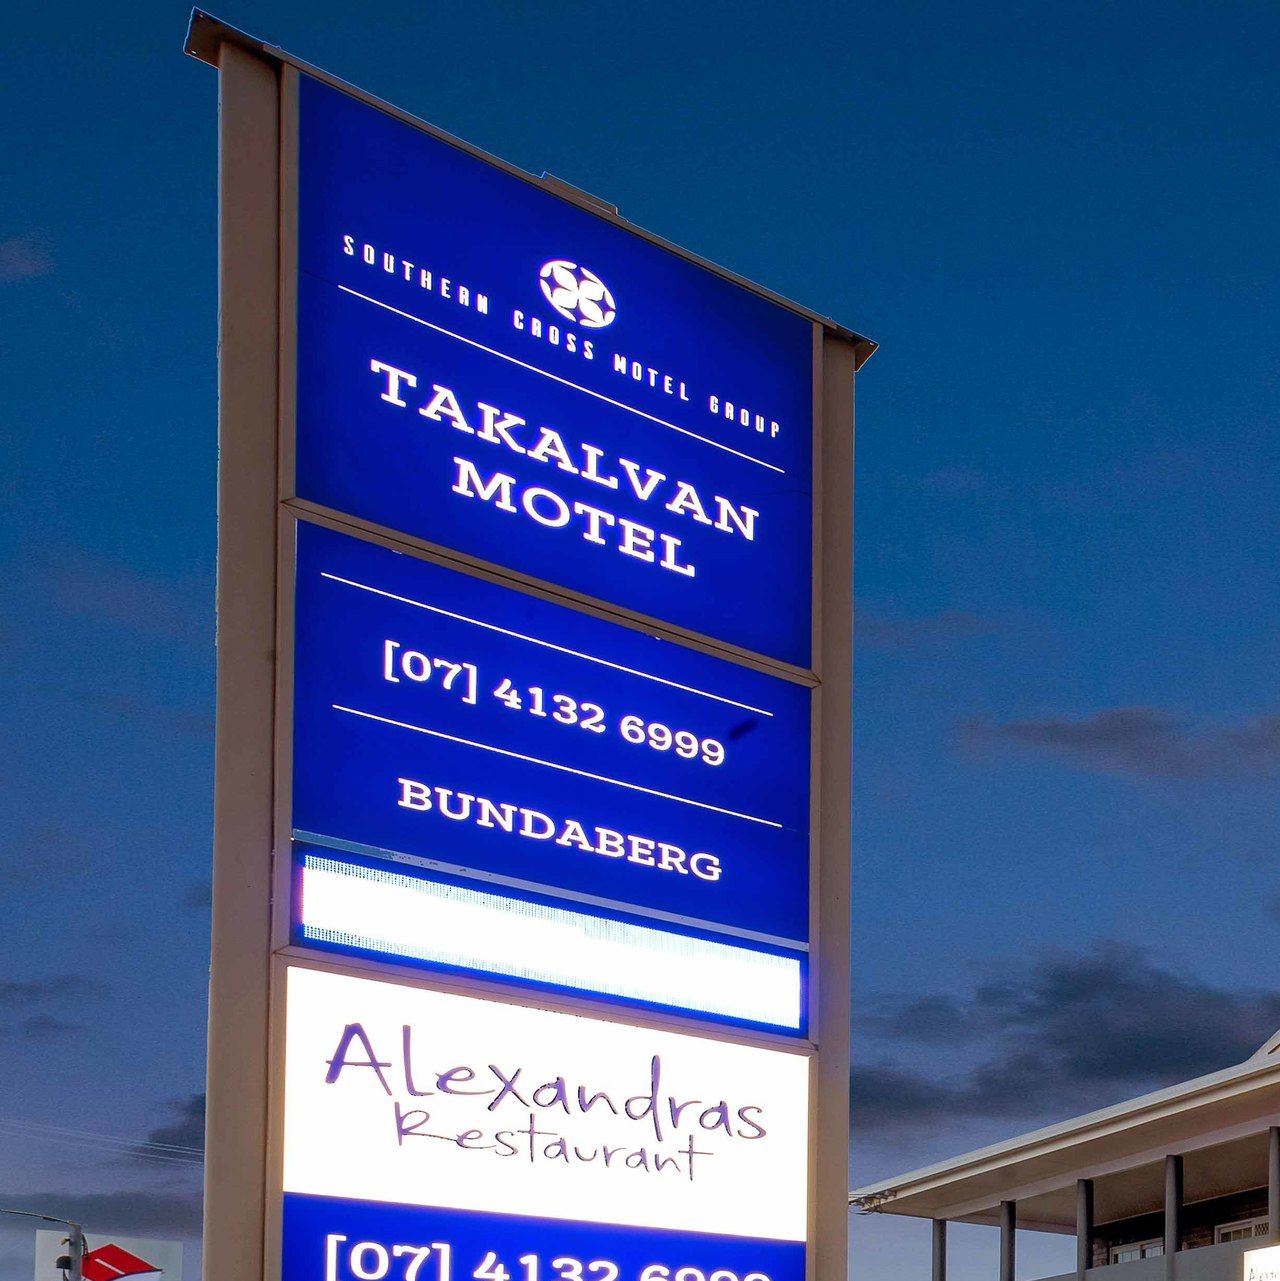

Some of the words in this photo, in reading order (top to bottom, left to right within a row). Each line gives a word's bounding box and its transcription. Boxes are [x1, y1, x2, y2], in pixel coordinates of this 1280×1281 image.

[342, 234, 490, 316] SOUTHERN
[512, 308, 595, 360] CROSS
[613, 353, 690, 402] MOTEL
[708, 394, 781, 439] GROUP
[370, 358, 760, 542] TAKALVAN
[452, 456, 696, 578] MOTEL
[382, 639, 477, 705] [07]
[493, 678, 607, 736] 4132
[620, 715, 726, 767] 6999
[396, 777, 723, 882] BUNDABERG
[325, 1022, 768, 1142] Alexandras
[394, 1101, 714, 1181] Restaurant
